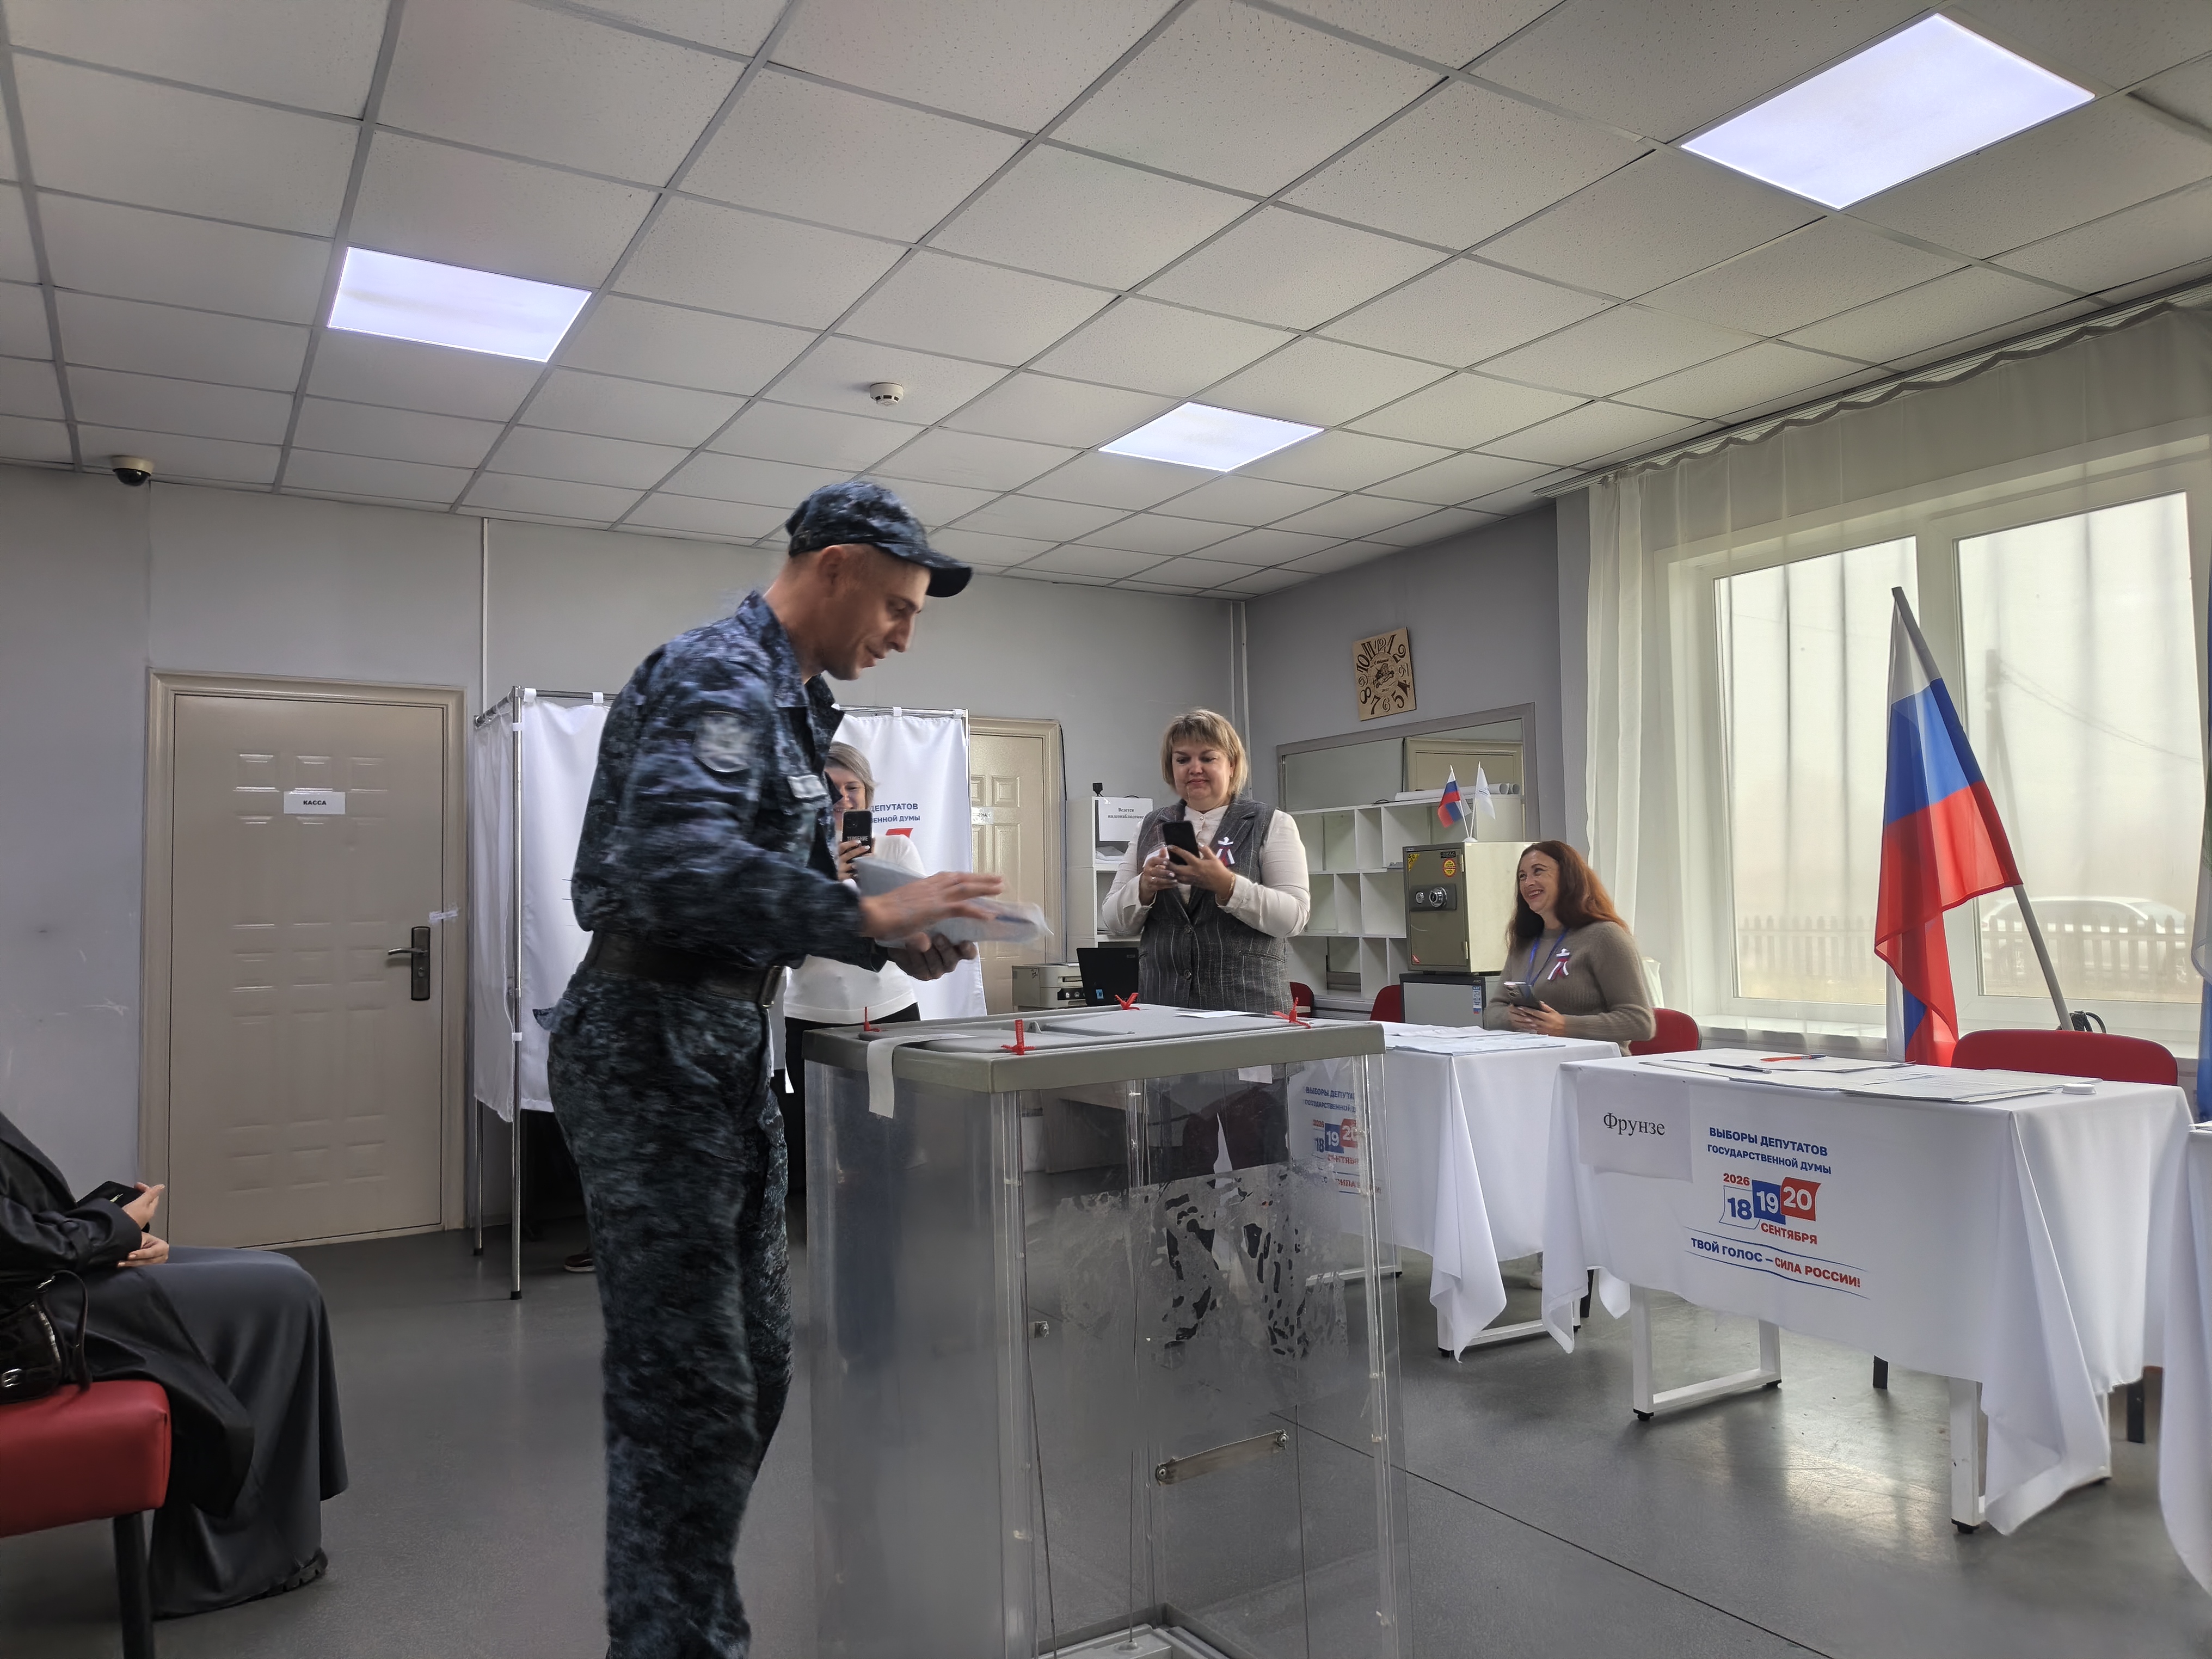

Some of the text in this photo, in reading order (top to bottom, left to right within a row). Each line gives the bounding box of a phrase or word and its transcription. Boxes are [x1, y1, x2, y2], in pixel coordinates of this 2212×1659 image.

[1392, 644, 1406, 663] 2
[1356, 654, 1370, 673] 10
[1360, 686, 1372, 704] 8
[1382, 697, 1391, 712] 6
[1391, 690, 1405, 708] 5
[1371, 695, 1381, 715] 7
[1603, 1113, 1665, 1136] Фрунзе
[1326, 1130, 1340, 1147] 19
[1710, 1127, 1828, 1156] ВЫБОРЫ ДЕПУТАТОВ
[1707, 1144, 1832, 1174] ГОСУДАРСТВЕННОЙ ДУМЫ
[1723, 1172, 1750, 1186] 2026
[1727, 1186, 1812, 1220] 18 19 20
[1761, 1222, 1817, 1245] СЕНТЯБРЯ
[1691, 1237, 1719, 1253] ТВОЙ
[1722, 1246, 1762, 1262] ГОЛОС
[1774, 1257, 1802, 1274] СИЛА
[1805, 1265, 1860, 1288] РОССИИ!
